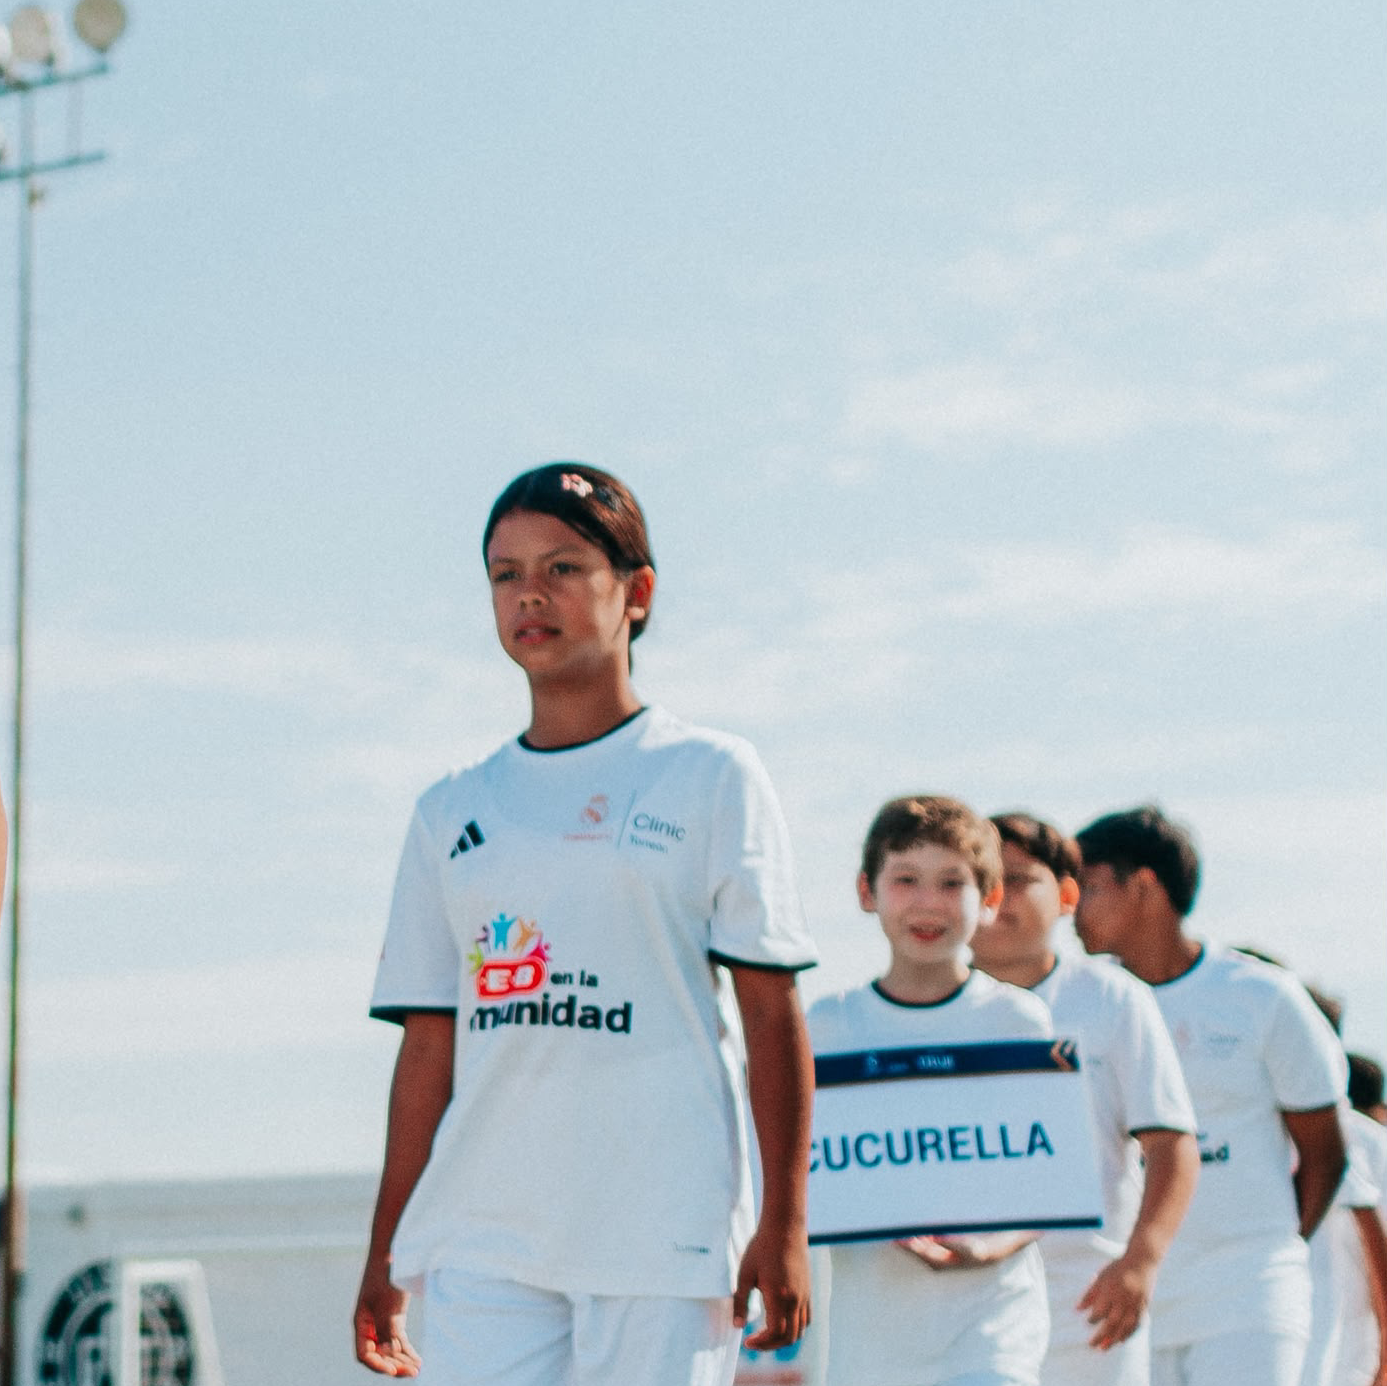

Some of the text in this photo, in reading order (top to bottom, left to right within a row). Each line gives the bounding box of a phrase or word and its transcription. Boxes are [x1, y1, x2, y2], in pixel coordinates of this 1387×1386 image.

[633, 812, 686, 841] Clinic
[550, 971, 573, 987] en
[580, 969, 599, 988] la
